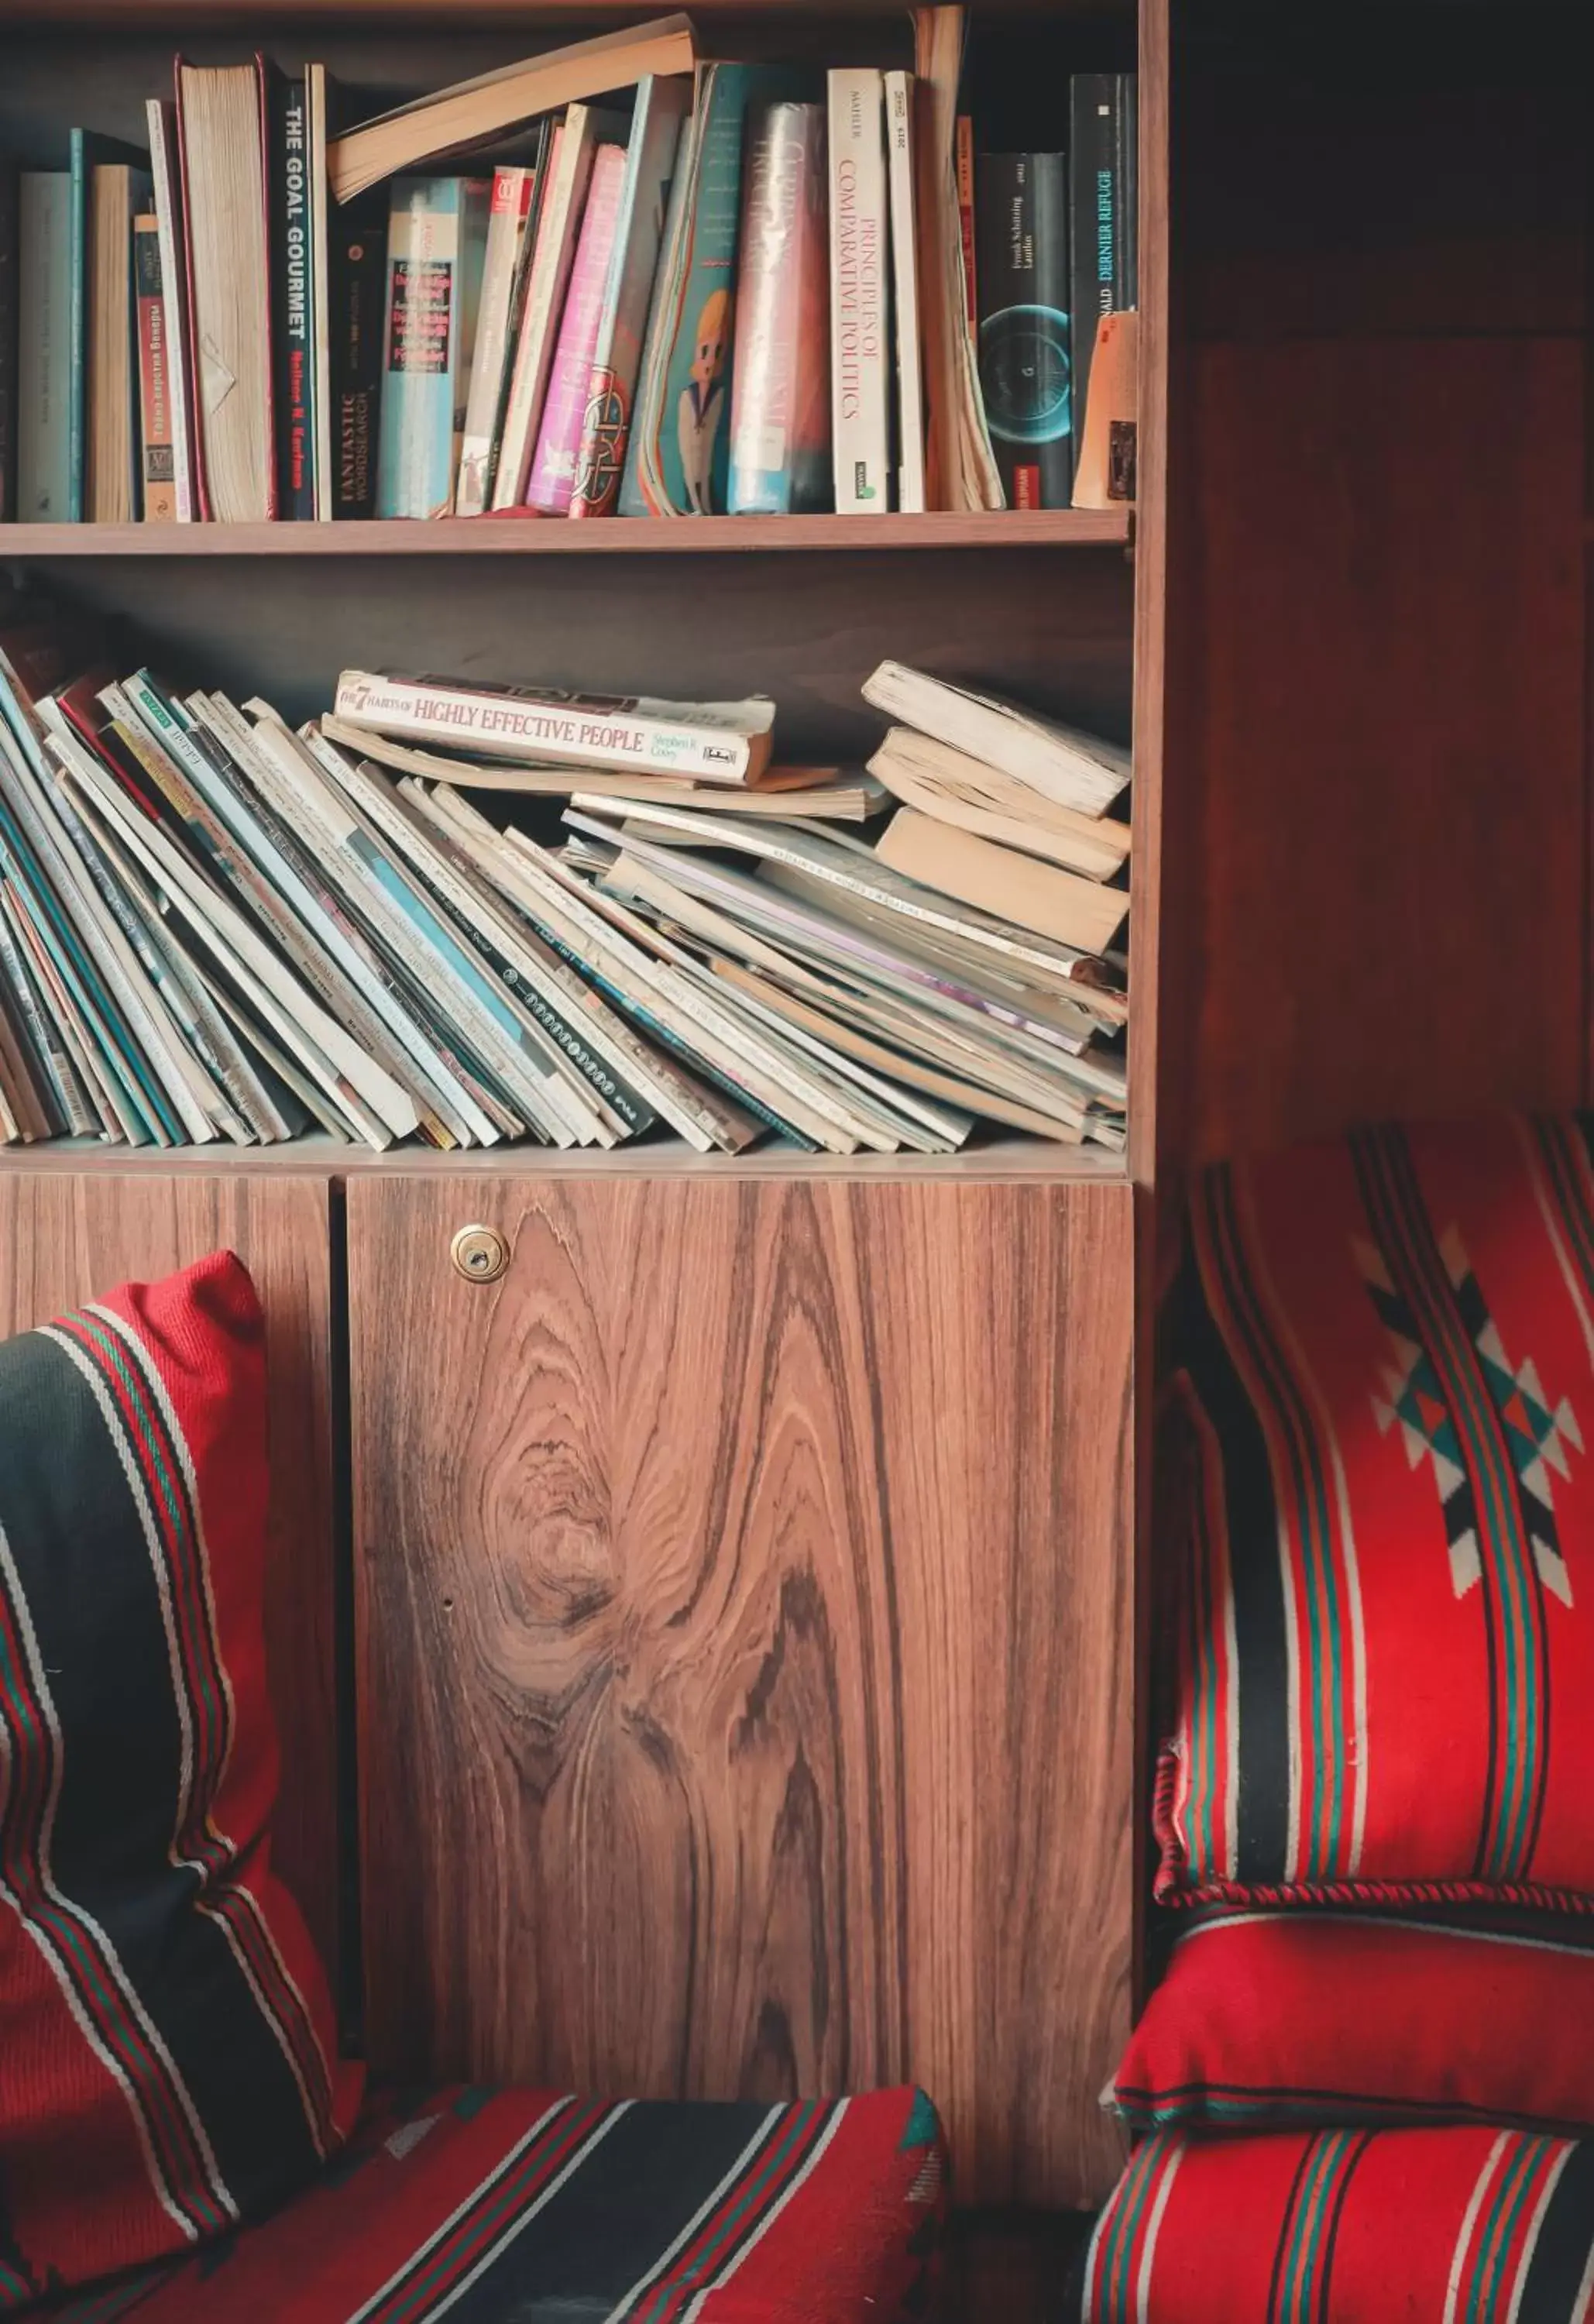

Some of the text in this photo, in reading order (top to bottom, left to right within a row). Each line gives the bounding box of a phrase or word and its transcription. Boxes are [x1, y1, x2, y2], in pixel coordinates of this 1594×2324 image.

[849, 89, 862, 139] MAHLER
[286, 106, 305, 339] THE GOAL GOURMET
[1097, 169, 1113, 221] REFUGE
[1097, 223, 1113, 281] DERNIER
[838, 158, 861, 420] COMPARATIVE POLITICS
[860, 218, 879, 362] PRINCIPLES OF
[147, 304, 160, 349] Венеры
[340, 391, 355, 502] FANTASTIC
[355, 391, 369, 502] WORDSEARCH
[339, 689, 357, 705] THE
[356, 686, 371, 711] 7
[367, 695, 400, 710] HABITS
[413, 698, 479, 728] HIGHLY
[480, 708, 575, 743] EFFECTIVE
[579, 724, 645, 754] PEOPLE
[653, 734, 689, 750] Stephen
